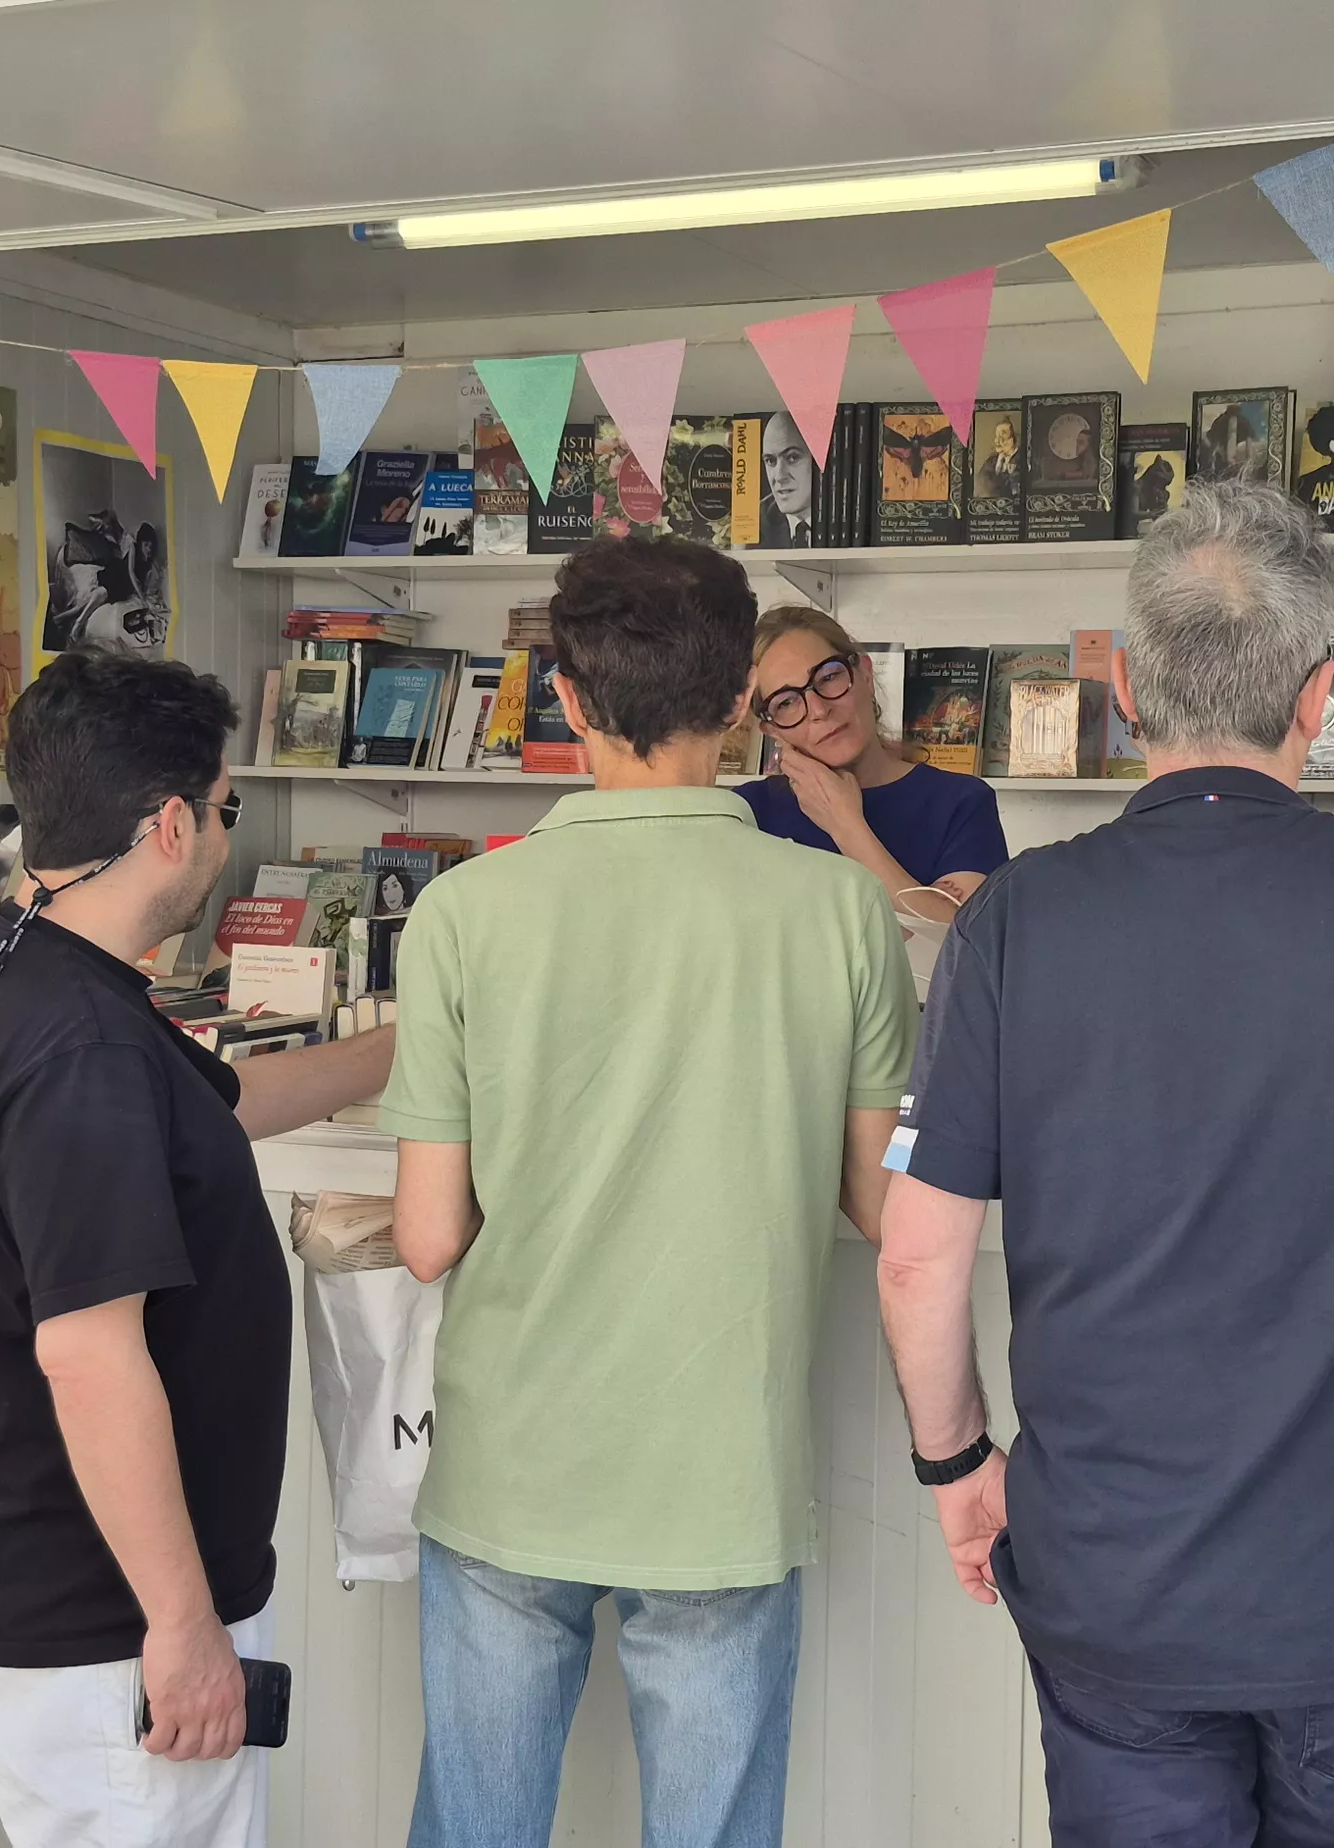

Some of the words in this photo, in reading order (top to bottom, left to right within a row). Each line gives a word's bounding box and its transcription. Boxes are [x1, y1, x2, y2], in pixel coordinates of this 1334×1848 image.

[737, 422, 746, 454] DAHL
[377, 459, 415, 470] Graziella
[377, 469, 411, 479] Moreno
[736, 460, 746, 495] ROALD
[428, 484, 436, 492] A
[441, 484, 473, 492] LUECA
[567, 506, 577, 514] EL
[367, 850, 429, 870] Almudena
[228, 902, 254, 913] JAVIER
[254, 903, 283, 914] CERCAS
[225, 913, 235, 922] El
[251, 915, 263, 924] de
[263, 915, 283, 925] Dios
[283, 918, 294, 926] en
[221, 924, 229, 934] el
[242, 924, 255, 935] del
[393, 1410, 434, 1450] M
